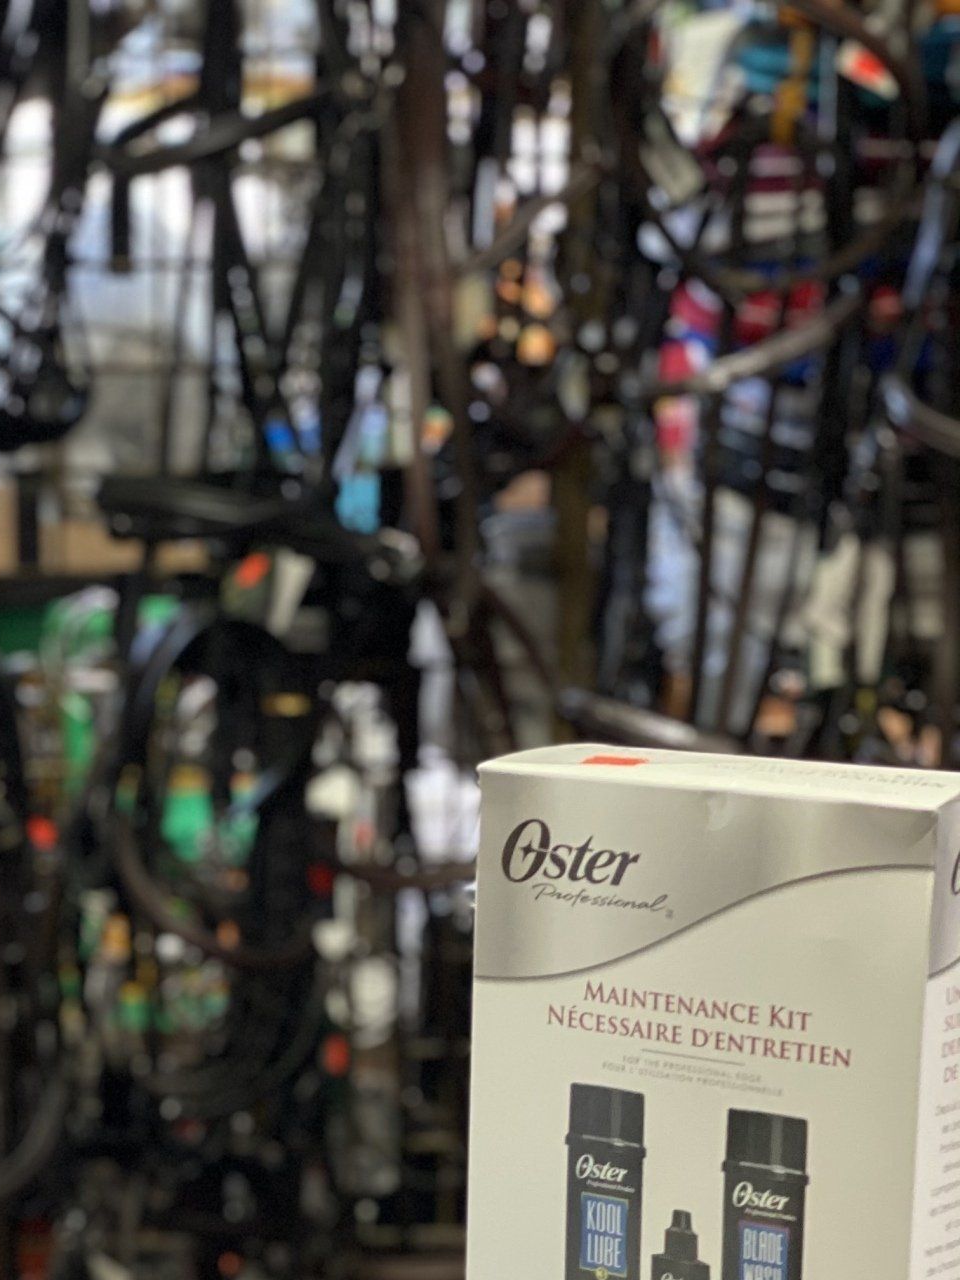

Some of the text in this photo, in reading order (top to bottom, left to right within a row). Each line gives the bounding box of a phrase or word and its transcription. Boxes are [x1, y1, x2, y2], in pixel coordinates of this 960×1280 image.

[502, 818, 642, 887] Oster
[532, 882, 670, 913] Professional
[583, 980, 813, 1032] MAINTENANCE KIT
[547, 1004, 852, 1068] NÉCESSAIRE D'ENTRETIEN
[575, 1153, 628, 1182] Oster
[732, 1181, 790, 1211] Oster
[586, 1200, 623, 1236] KOOL
[587, 1233, 621, 1269] LUBE
[743, 1228, 783, 1266] BLADE
